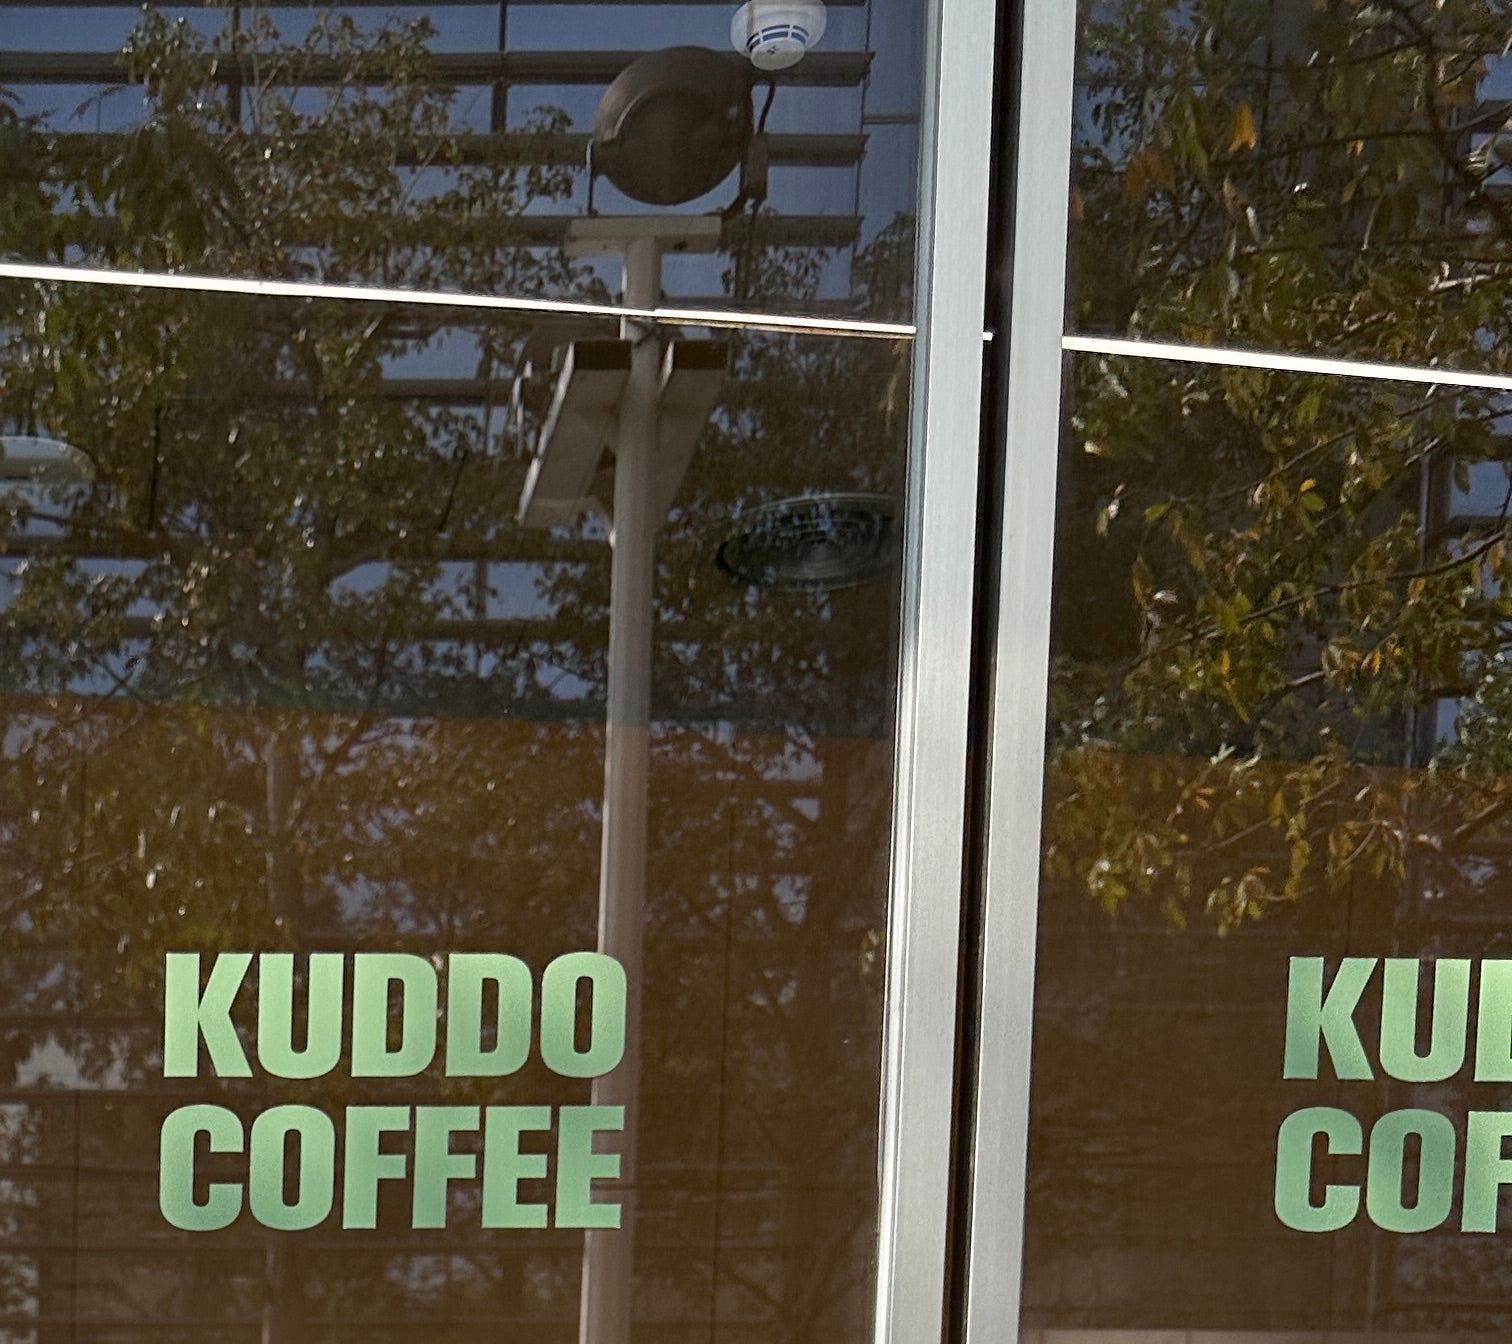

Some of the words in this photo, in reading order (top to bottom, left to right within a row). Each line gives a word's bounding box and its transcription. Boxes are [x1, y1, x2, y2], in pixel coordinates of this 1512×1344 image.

[163, 952, 627, 1079] KUDDO
[1283, 956, 1512, 1082] KU
[160, 1104, 626, 1231] COFFEE
[1274, 1106, 1512, 1233] COF
